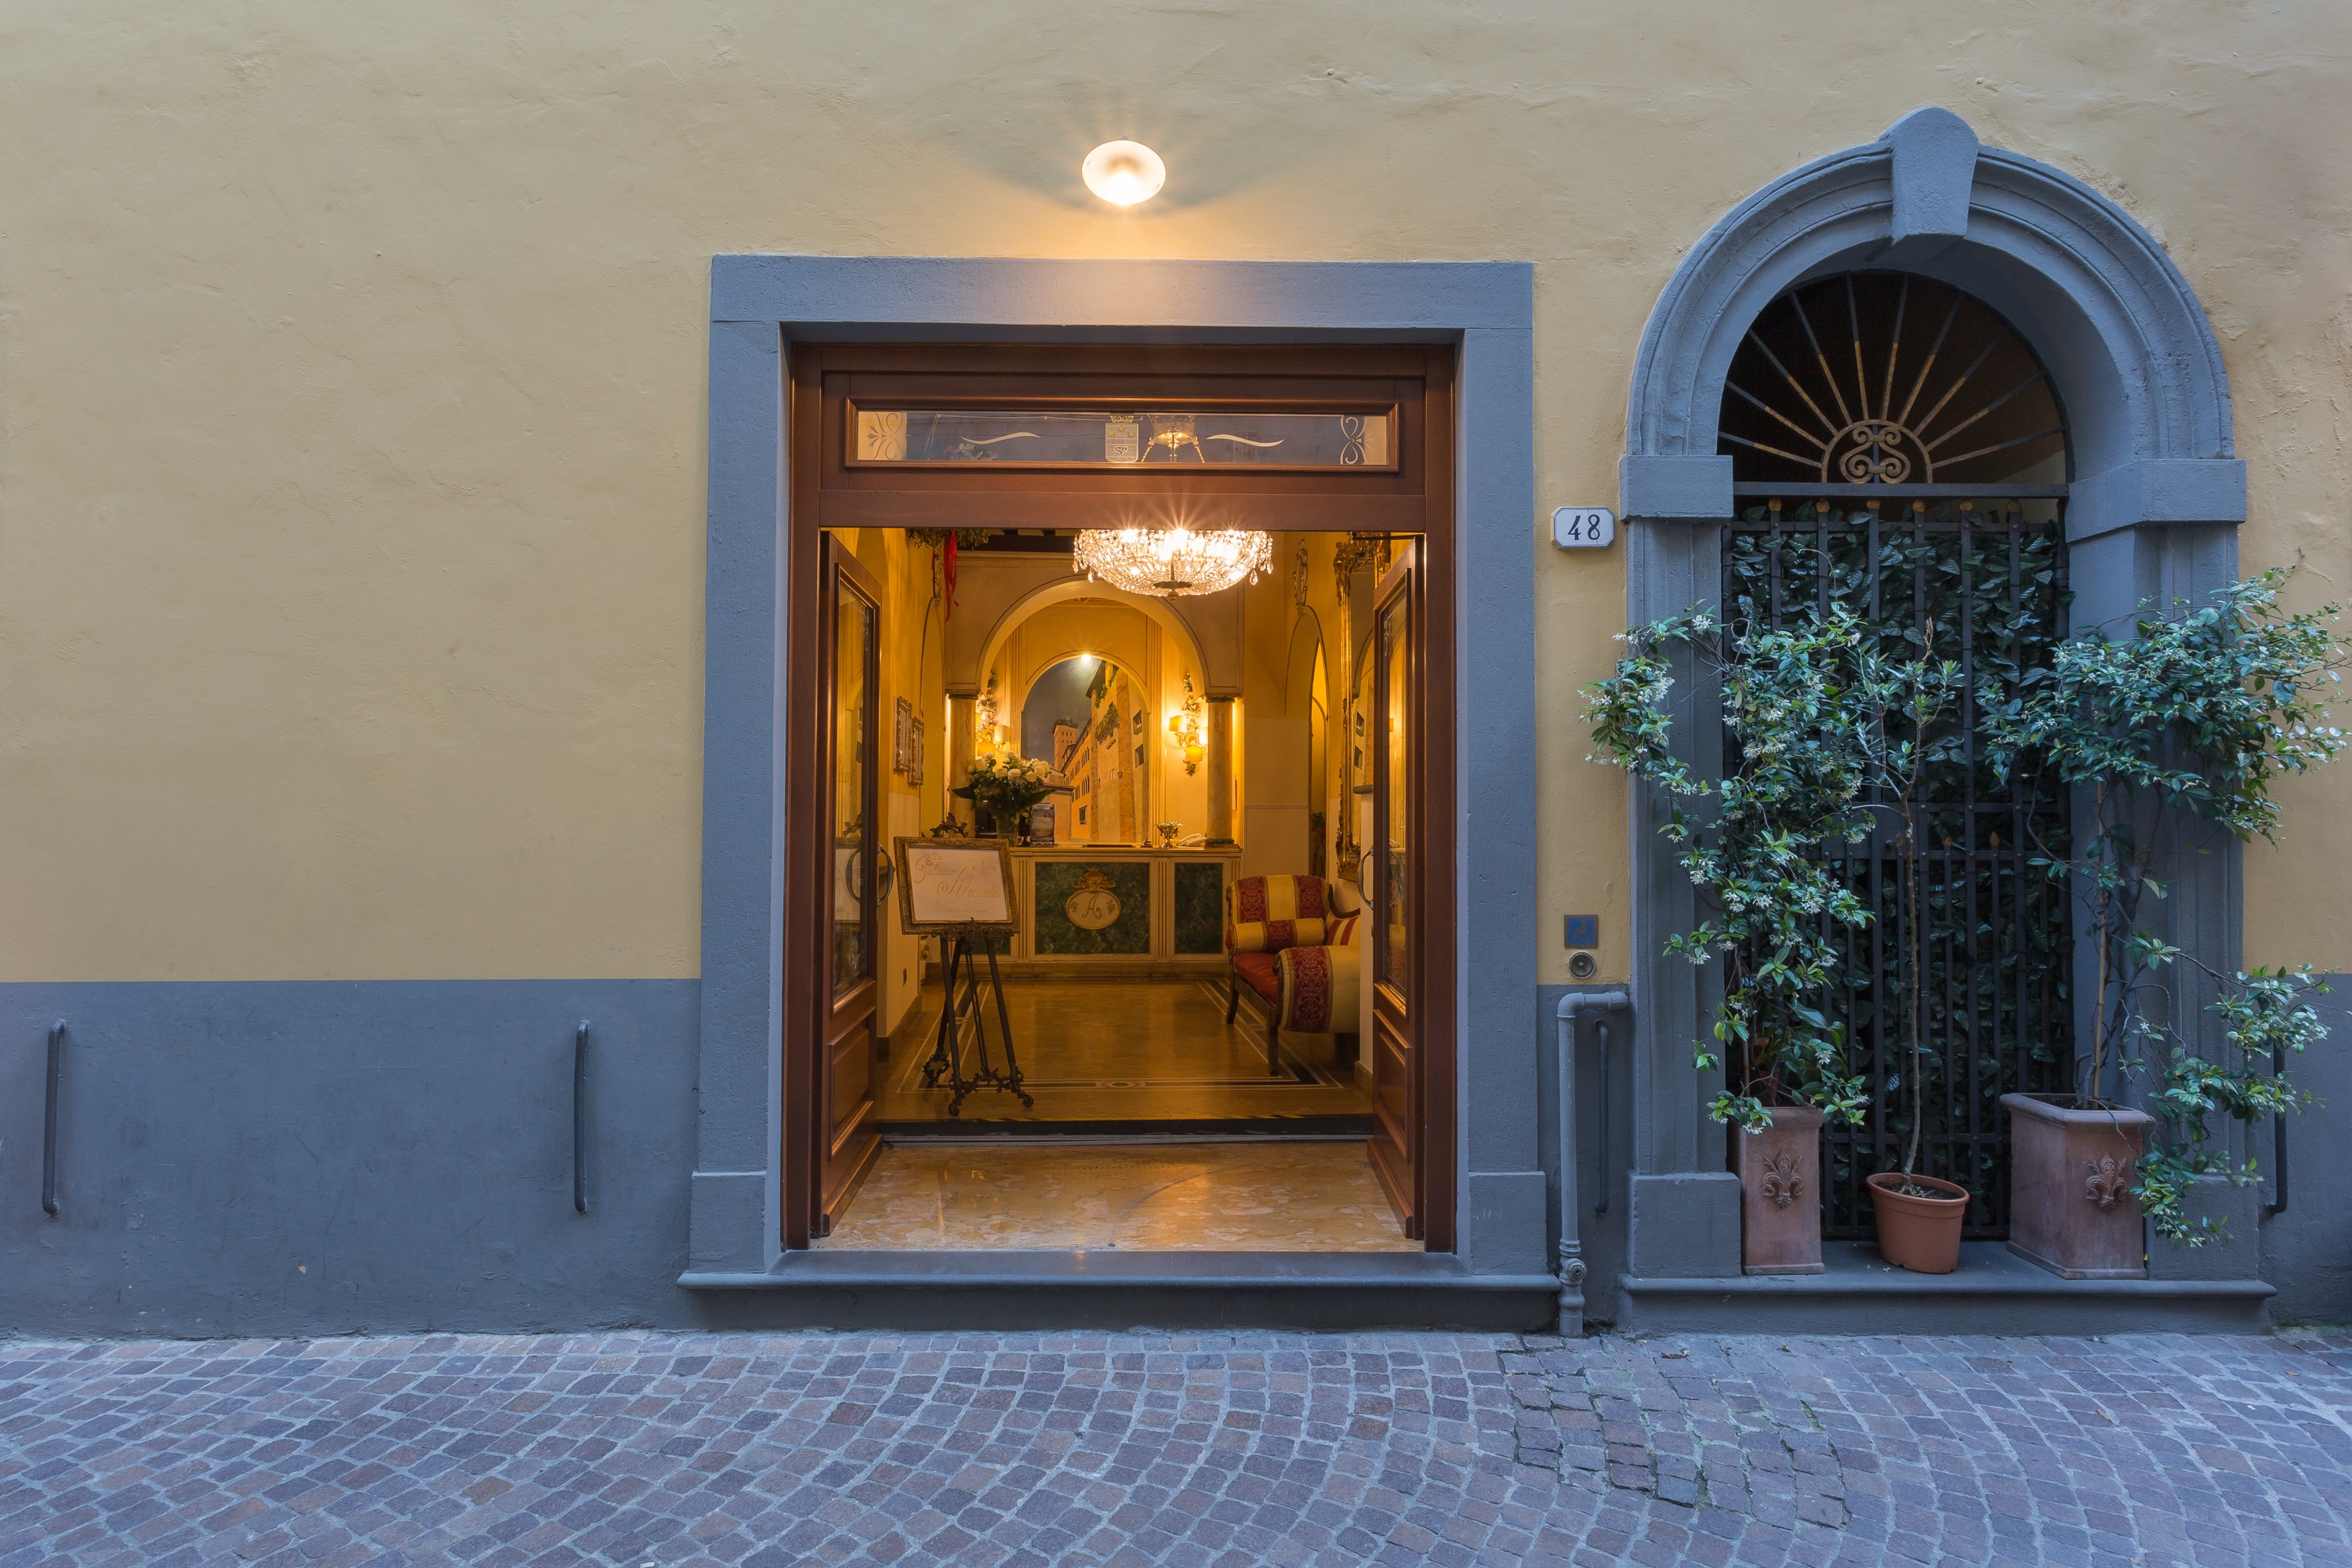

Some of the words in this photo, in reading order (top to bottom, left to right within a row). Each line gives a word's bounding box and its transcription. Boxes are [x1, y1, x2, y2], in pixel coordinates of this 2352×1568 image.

[1567, 514, 1601, 541] 48
[914, 852, 958, 884] Palazzo
[1081, 894, 1102, 920] A
